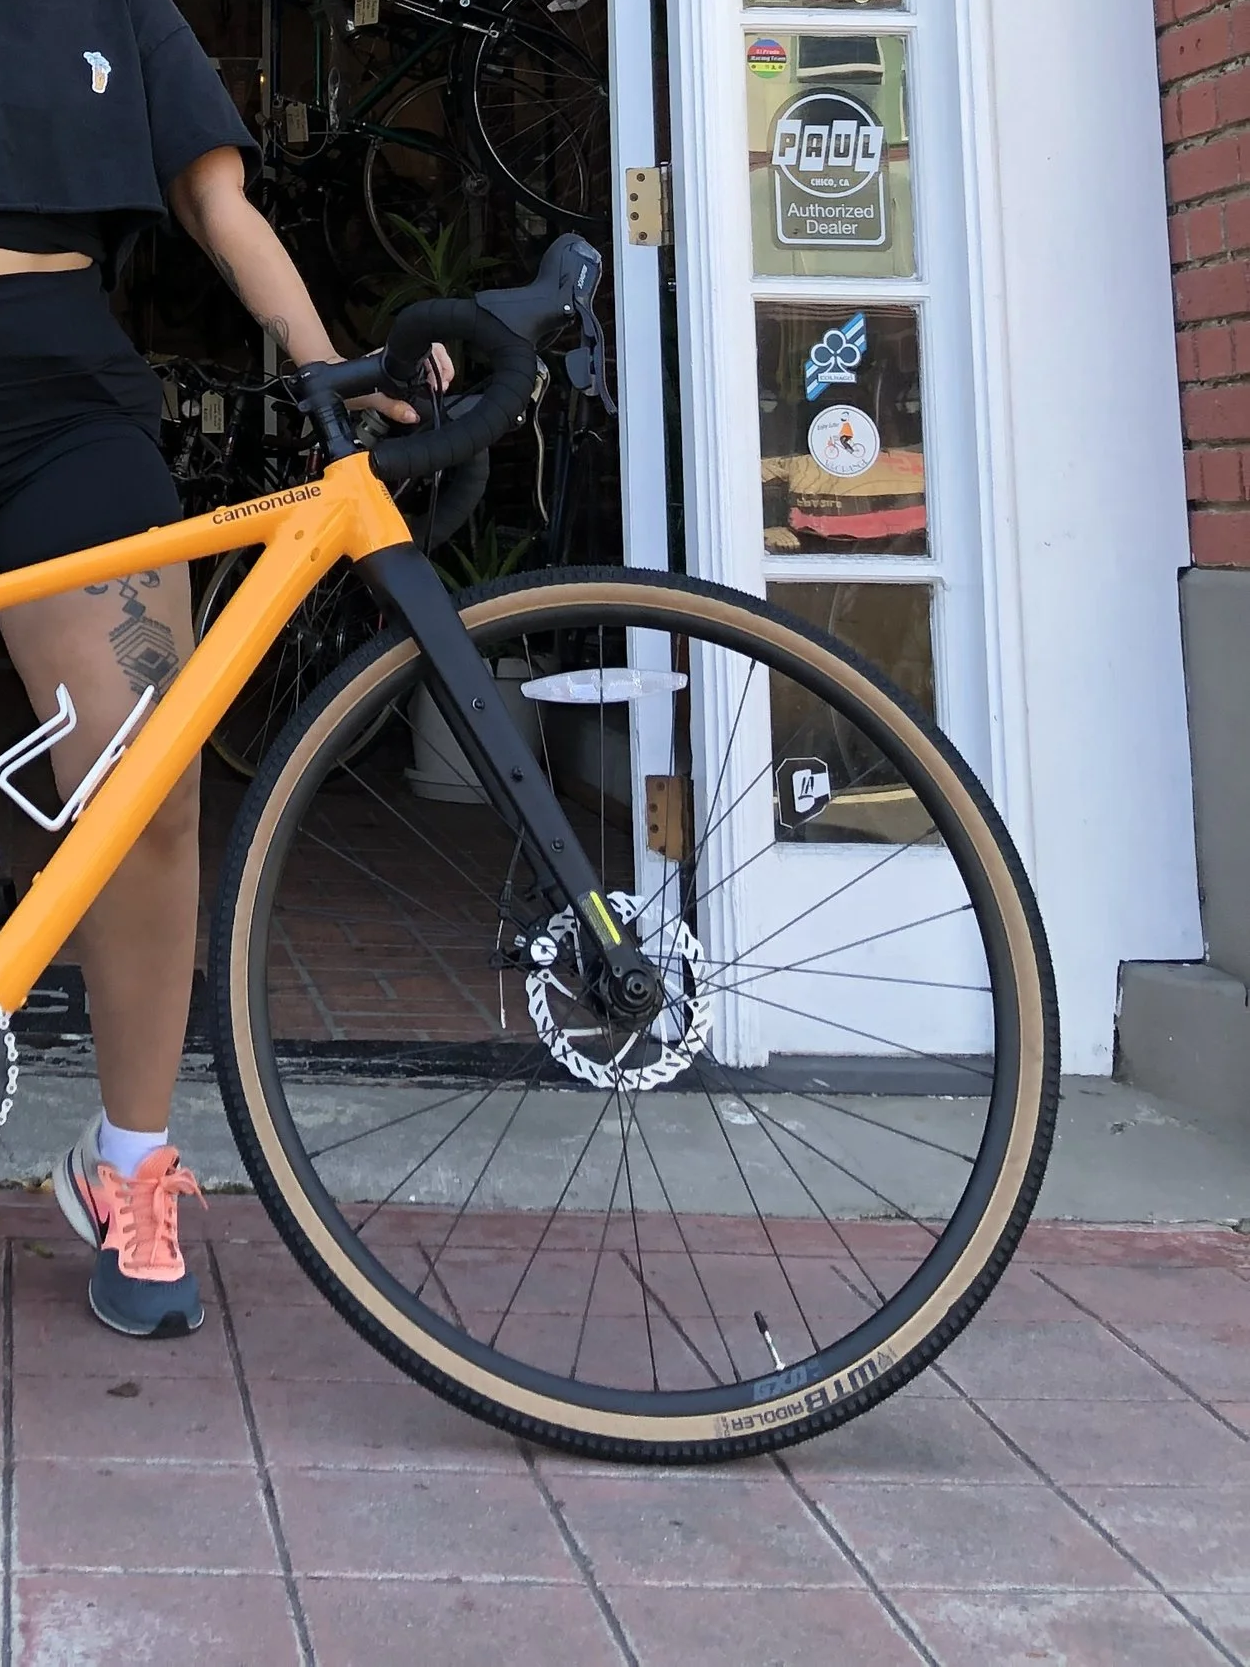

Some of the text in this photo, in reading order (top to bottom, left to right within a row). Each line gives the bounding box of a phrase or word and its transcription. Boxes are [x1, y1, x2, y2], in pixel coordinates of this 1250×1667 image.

[778, 132, 876, 159] PAUL
[810, 178, 850, 188] CHICO, CA
[787, 202, 875, 219] Authorized
[806, 220, 858, 235] Dealer
[212, 486, 322, 525] cannondale
[804, 1357, 879, 1414] WTB
[731, 1400, 804, 1431] RIDDLER
